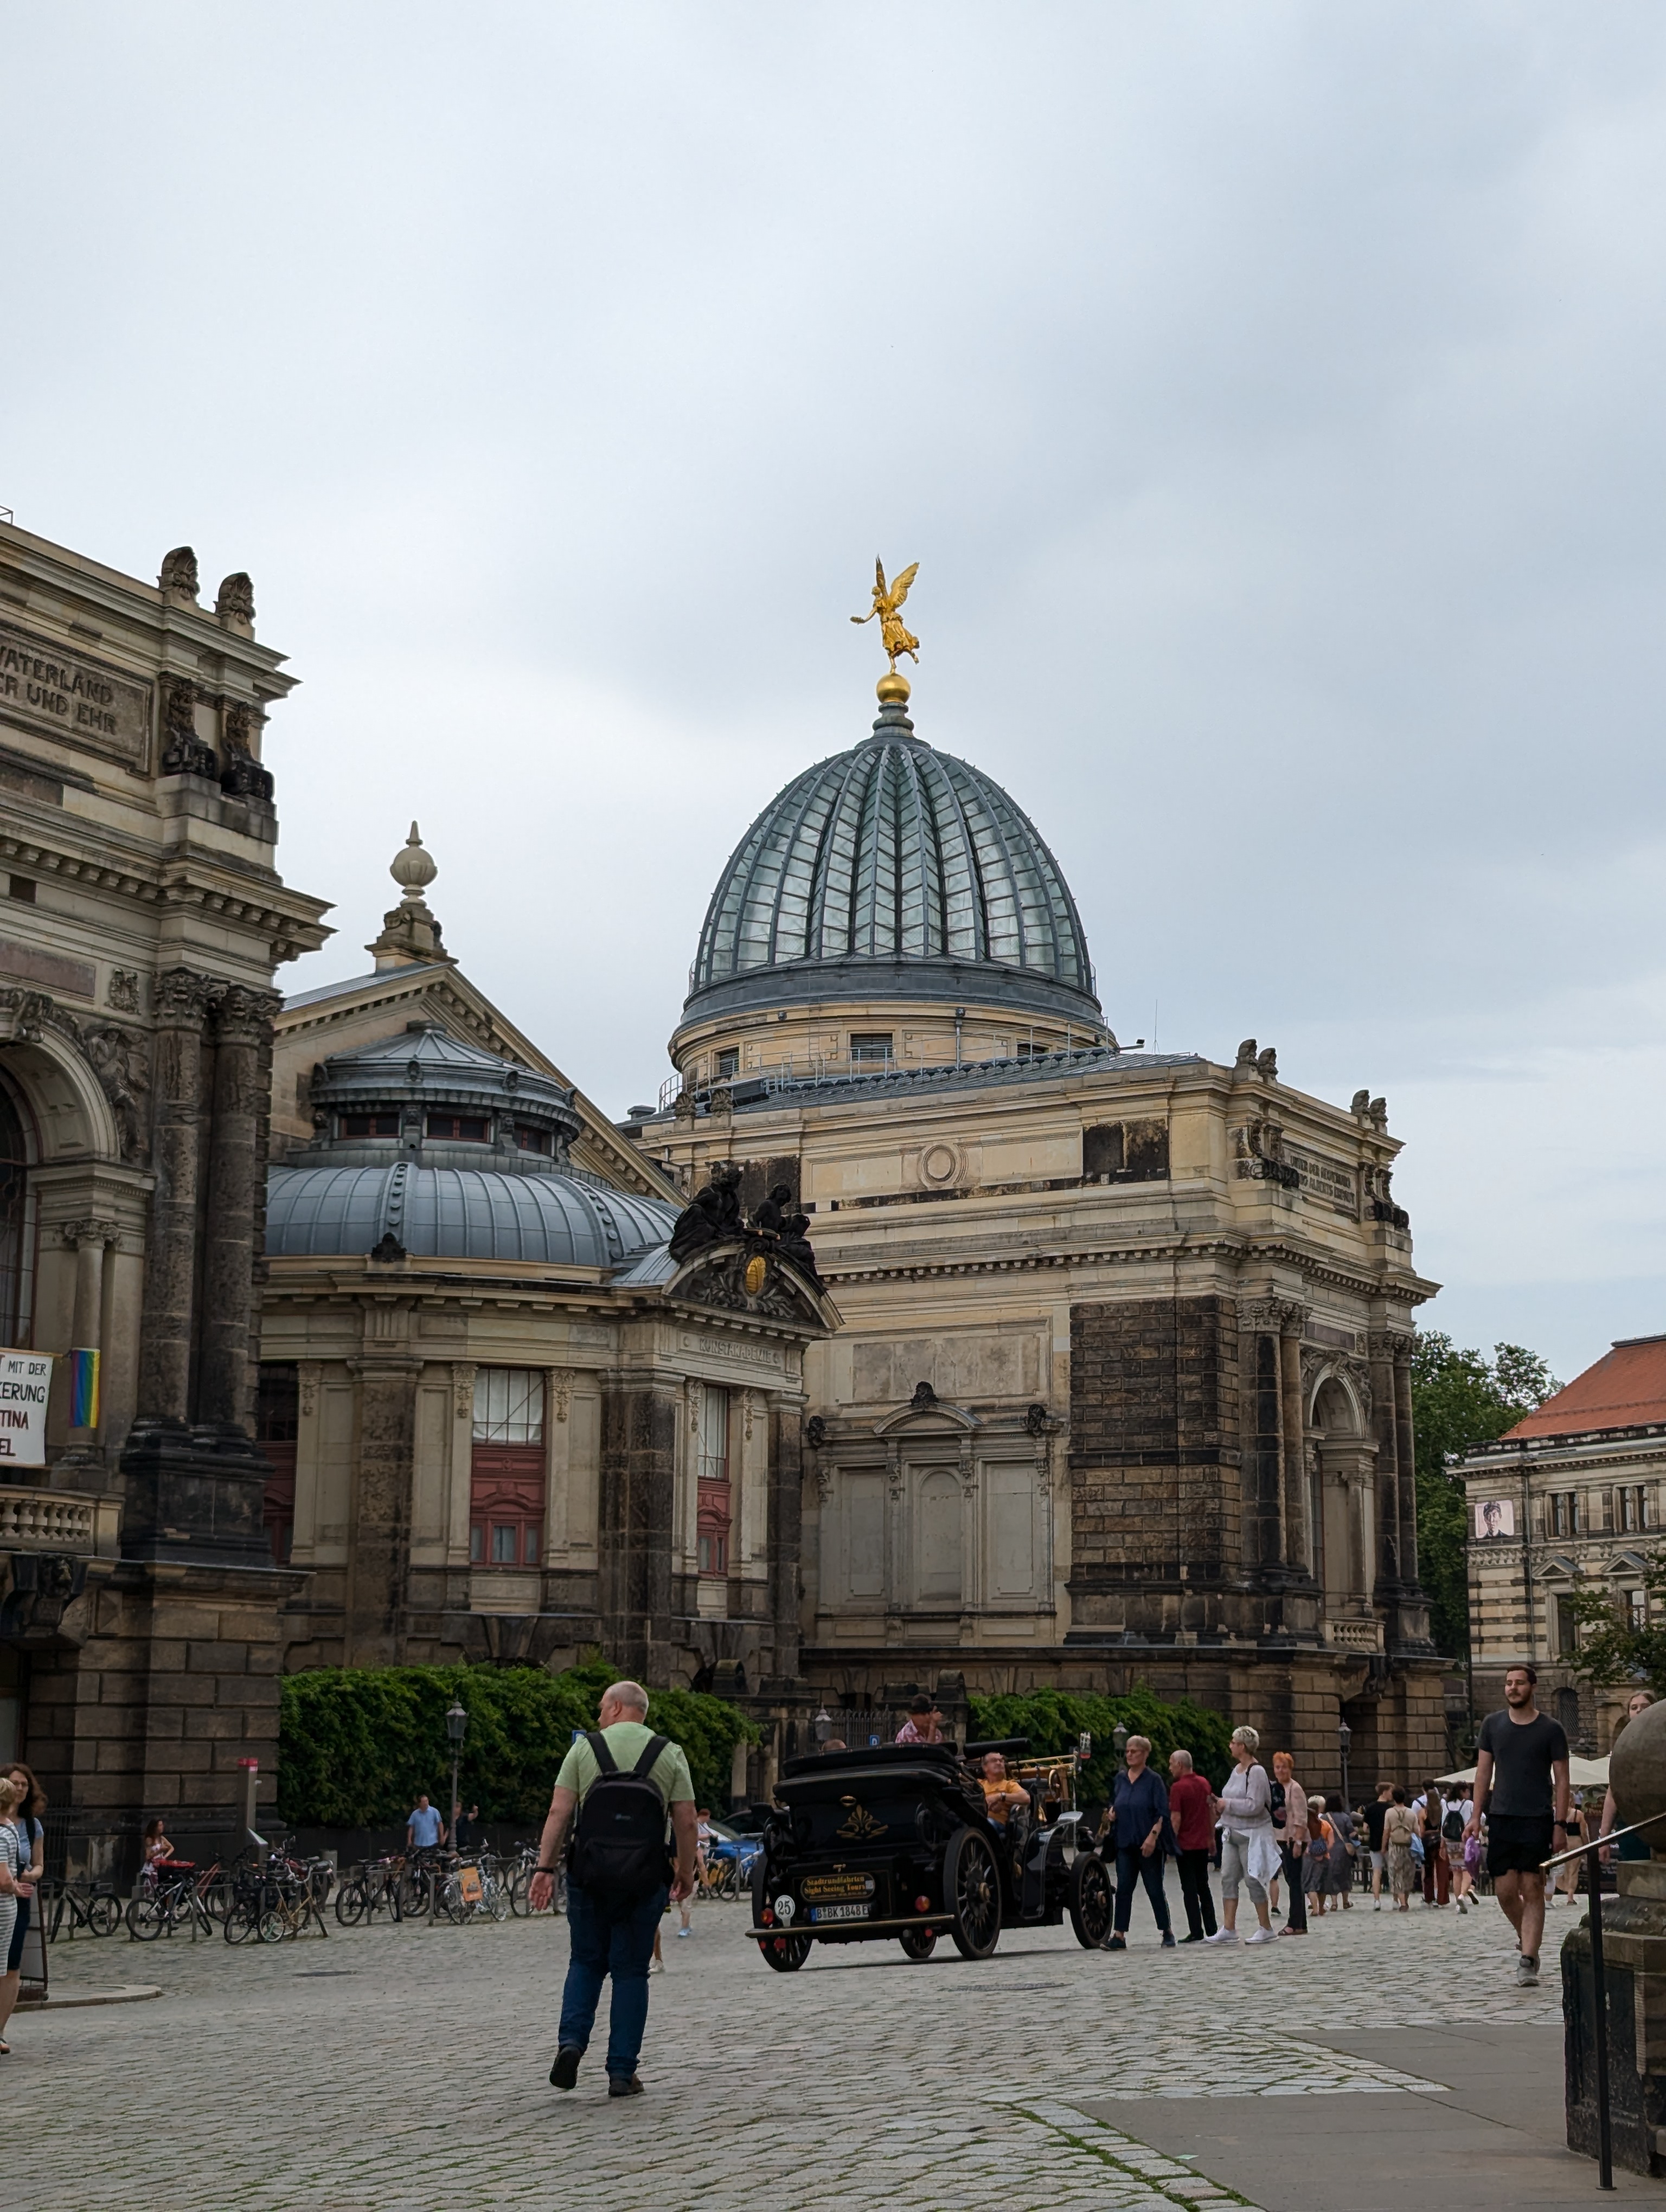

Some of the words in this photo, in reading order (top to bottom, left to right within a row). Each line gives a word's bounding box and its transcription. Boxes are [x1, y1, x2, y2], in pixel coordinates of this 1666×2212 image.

[28, 683, 70, 716] UND
[78, 703, 116, 735] EHR
[700, 1338, 771, 1364] KUNSTAKADEMIE
[8, 1360, 25, 1373] MIT
[29, 1362, 47, 1375] DER
[778, 1900, 791, 1915] 25
